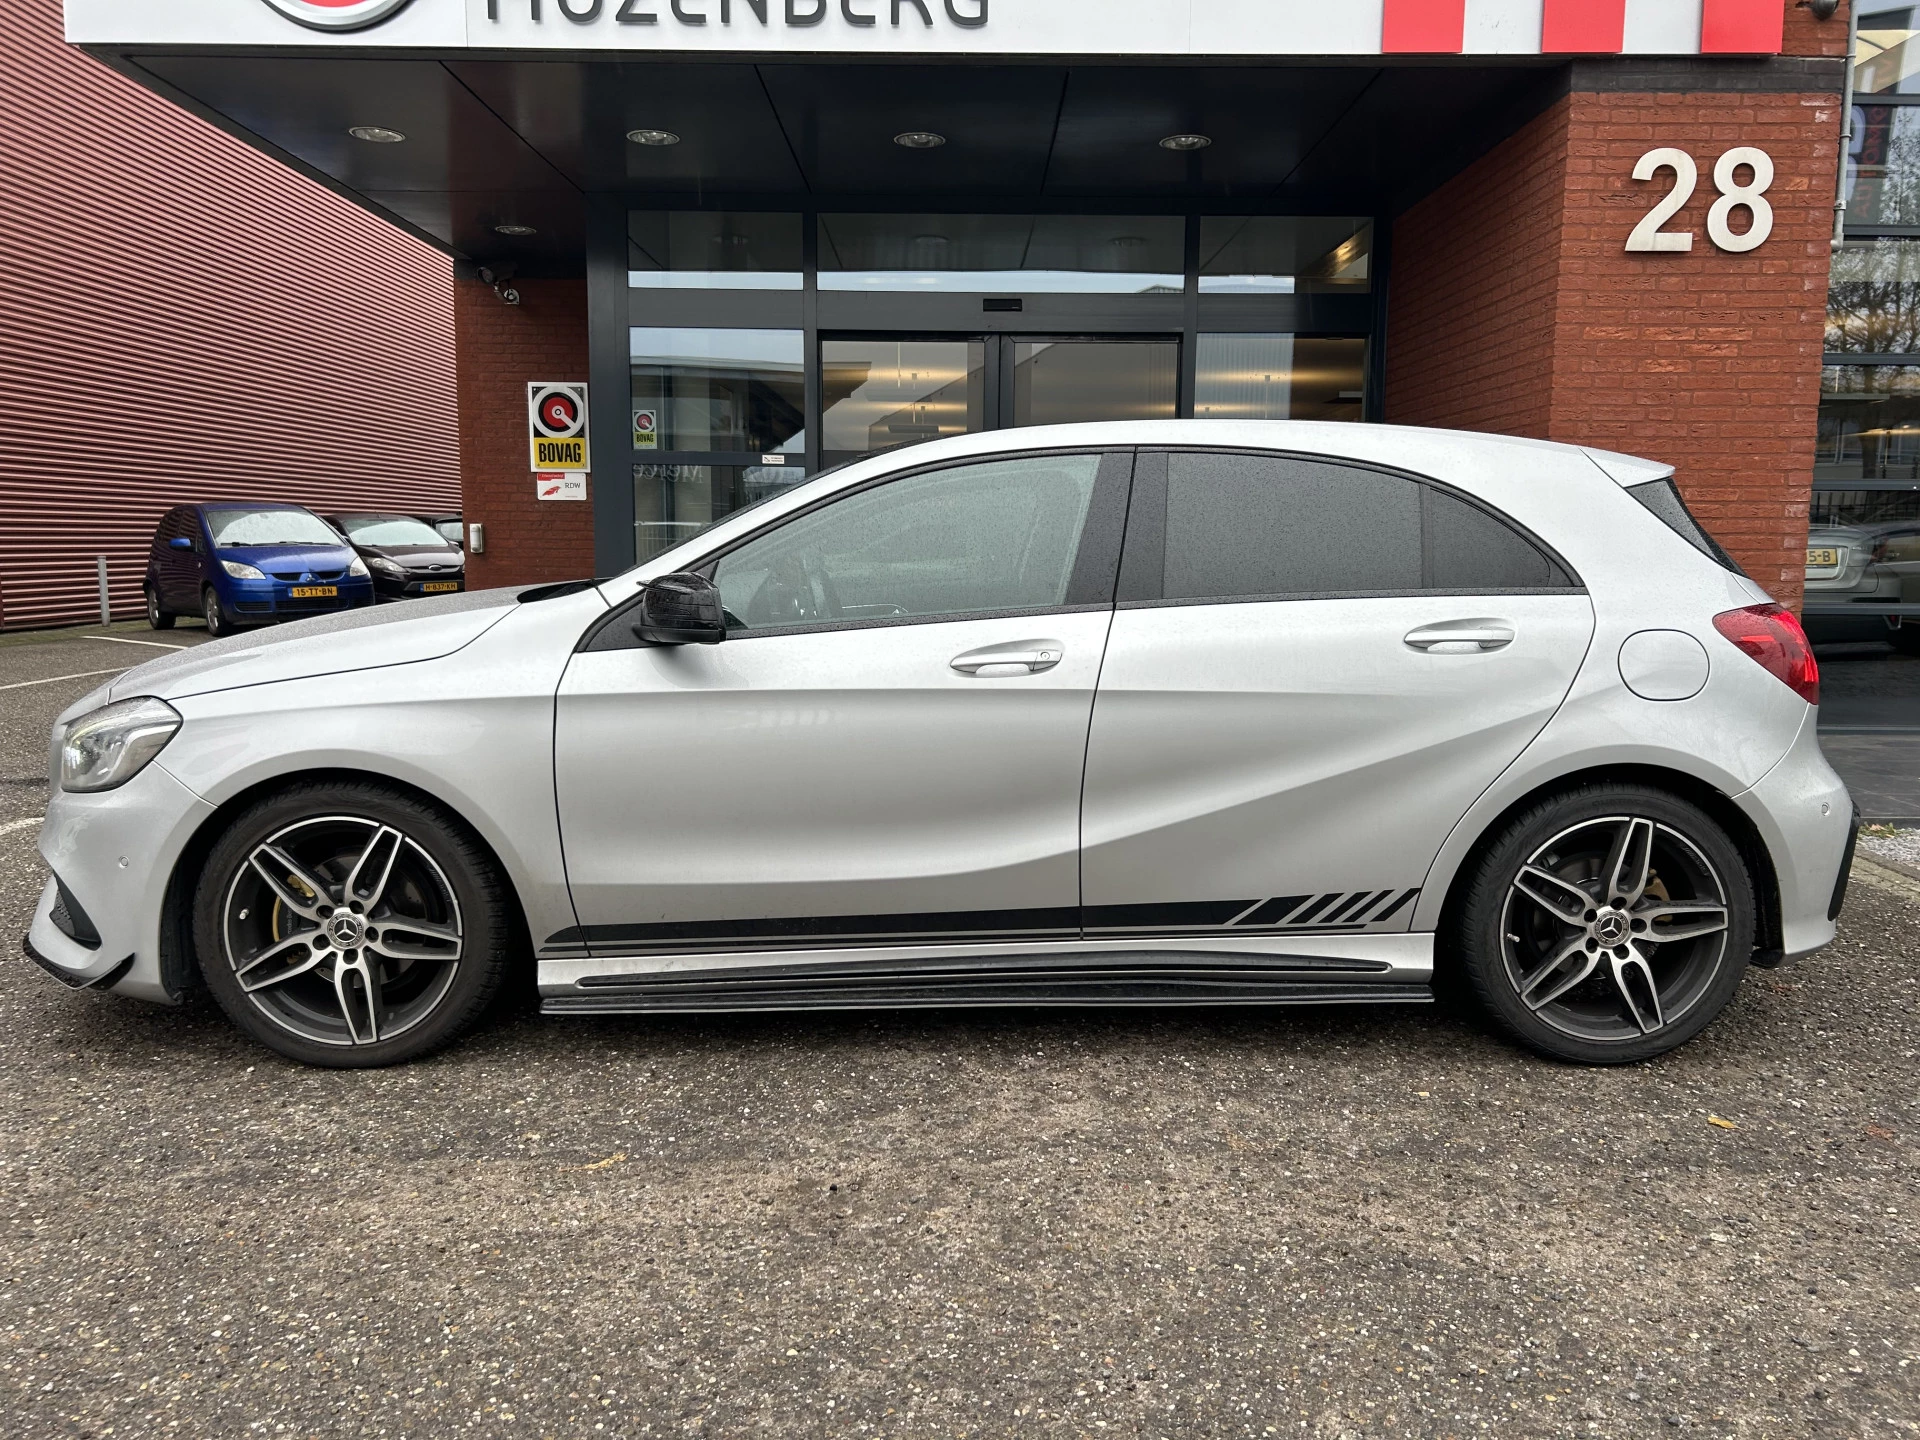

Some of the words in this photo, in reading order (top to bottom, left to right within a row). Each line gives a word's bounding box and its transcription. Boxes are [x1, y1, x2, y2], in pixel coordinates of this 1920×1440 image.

[1625, 146, 1774, 252] 28
[636, 433, 654, 443] BOVAG
[538, 442, 582, 463] BOVAG
